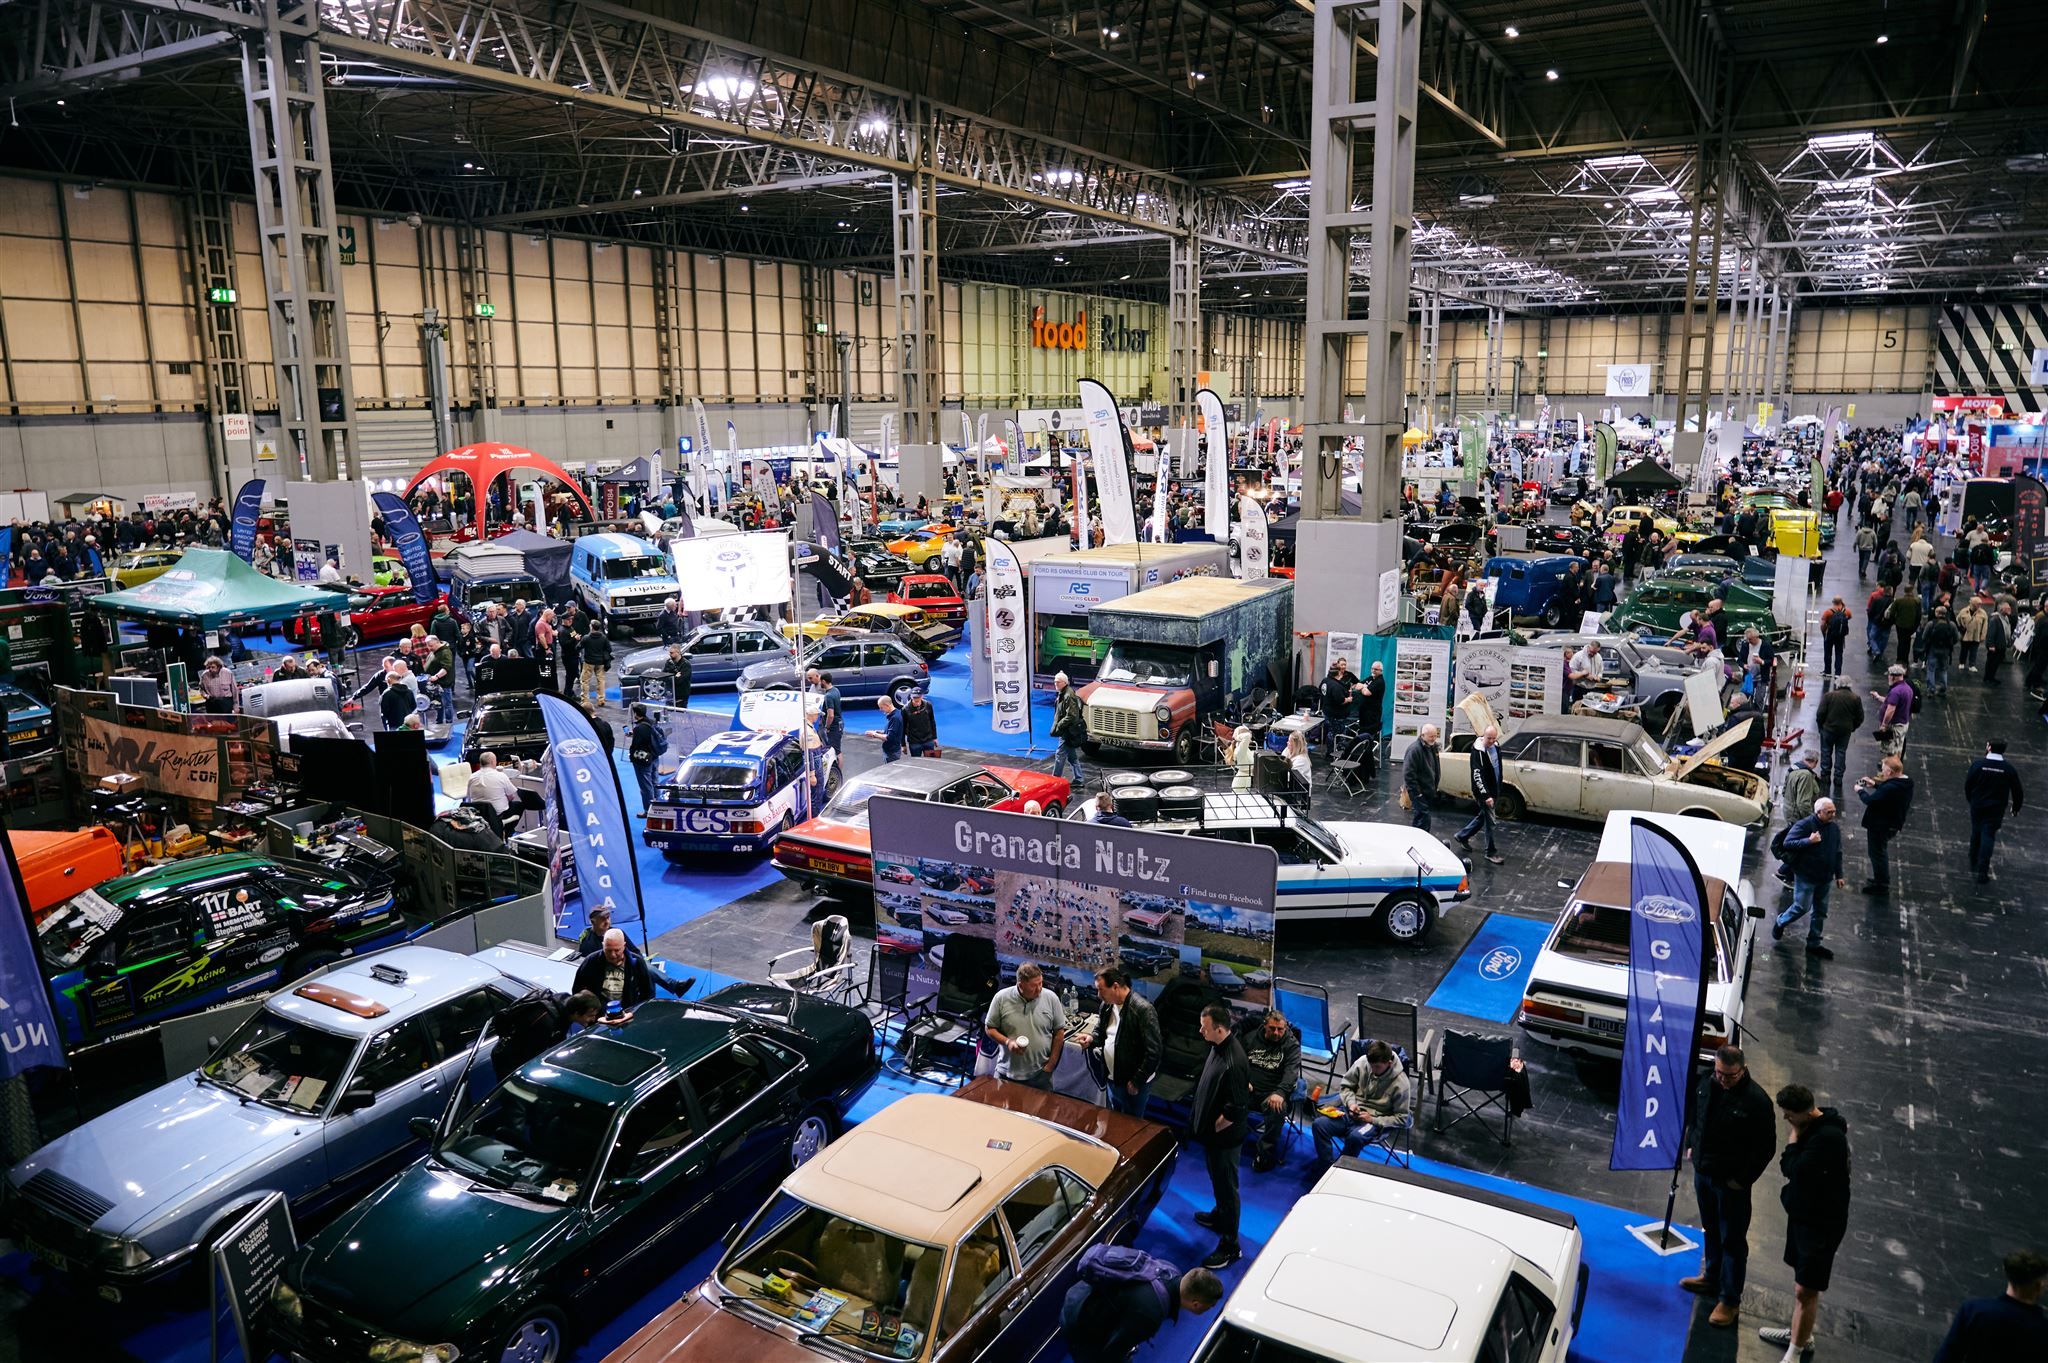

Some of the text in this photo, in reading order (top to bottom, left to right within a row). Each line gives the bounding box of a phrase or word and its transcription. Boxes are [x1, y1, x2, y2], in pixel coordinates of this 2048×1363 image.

[1032, 305, 1149, 352] food & bar
[1884, 331, 1897, 348] 5
[1141, 401, 1160, 411] MADE
[1962, 399, 1995, 407] MOTUL
[227, 418, 244, 426] Fire
[227, 427, 248, 436] point
[1970, 432, 1980, 458] AROC
[464, 527, 477, 536] 184
[403, 546, 421, 555] UNITED
[404, 552, 426, 562] KINGDOM
[829, 555, 851, 581] START
[993, 558, 1010, 567] RS
[1146, 569, 1158, 583] RS
[23, 588, 55, 600] Ford
[1069, 583, 1091, 594] RS
[1462, 652, 1477, 665] FORD
[1478, 650, 1506, 664] CORSAIR
[994, 661, 1019, 673] RS
[995, 680, 1020, 694] RS
[1486, 690, 1502, 702] CLUB
[997, 701, 1020, 713] RS
[999, 718, 1021, 729] RS
[155, 749, 217, 780] Register
[723, 758, 755, 766] SPORT
[673, 808, 730, 833] ICS
[954, 820, 1171, 883] Granada Nutz
[201, 892, 230, 913] 117
[1190, 886, 1206, 897] Find
[1208, 890, 1218, 898] us
[1229, 892, 1264, 906] Facebook
[228, 900, 261, 918] BART
[1643, 898, 1684, 920] Ford
[223, 914, 254, 929] MEMORY
[255, 910, 264, 918] OF
[80, 924, 105, 943] 117
[215, 924, 244, 937] Stephen
[1485, 951, 1517, 975] Ford
[916, 974, 934, 985] Nutz
[143, 991, 164, 1003] TNT
[1639, 939, 1672, 1148] GRANADA
[238, 1218, 270, 1249] ALL VEHICLE
[241, 1225, 270, 1253] LOCKSMITH
[245, 1232, 269, 1256] SERVICES
[249, 1243, 271, 1265] Lost keys
[250, 1253, 275, 1278] Spare keys
